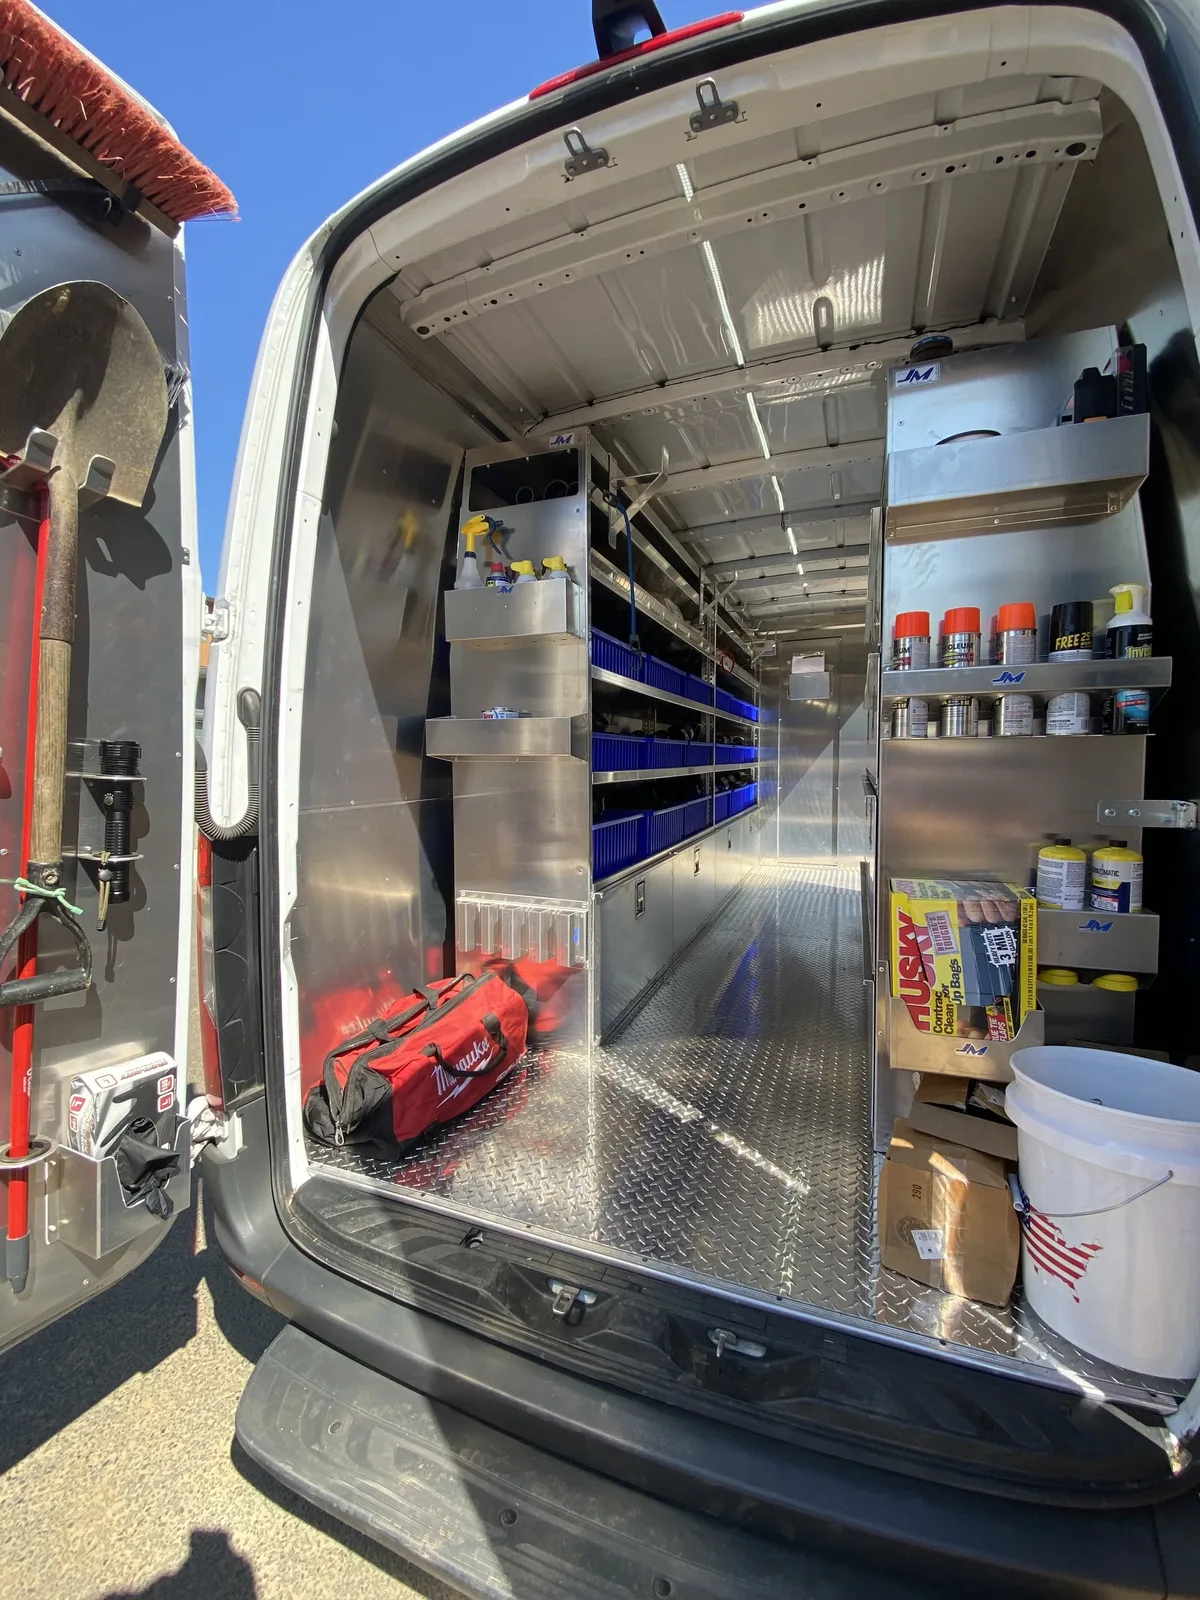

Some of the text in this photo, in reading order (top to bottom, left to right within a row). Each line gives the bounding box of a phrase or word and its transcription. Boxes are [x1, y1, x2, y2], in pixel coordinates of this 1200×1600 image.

[897, 367, 934, 383] JM
[550, 434, 573, 445] JM
[497, 585, 513, 593] JM
[1056, 634, 1080, 650] FREE
[992, 671, 1026, 683] JM
[1079, 920, 1113, 932] JM
[985, 932, 1000, 964] HEAVY DUTY
[993, 932, 1008, 950] MIL
[1005, 930, 1016, 951] GALLON
[949, 959, 961, 988] Bags
[955, 1043, 988, 1056] JM
[430, 1036, 490, 1096] Milaukee
[912, 1184, 922, 1200] 290
